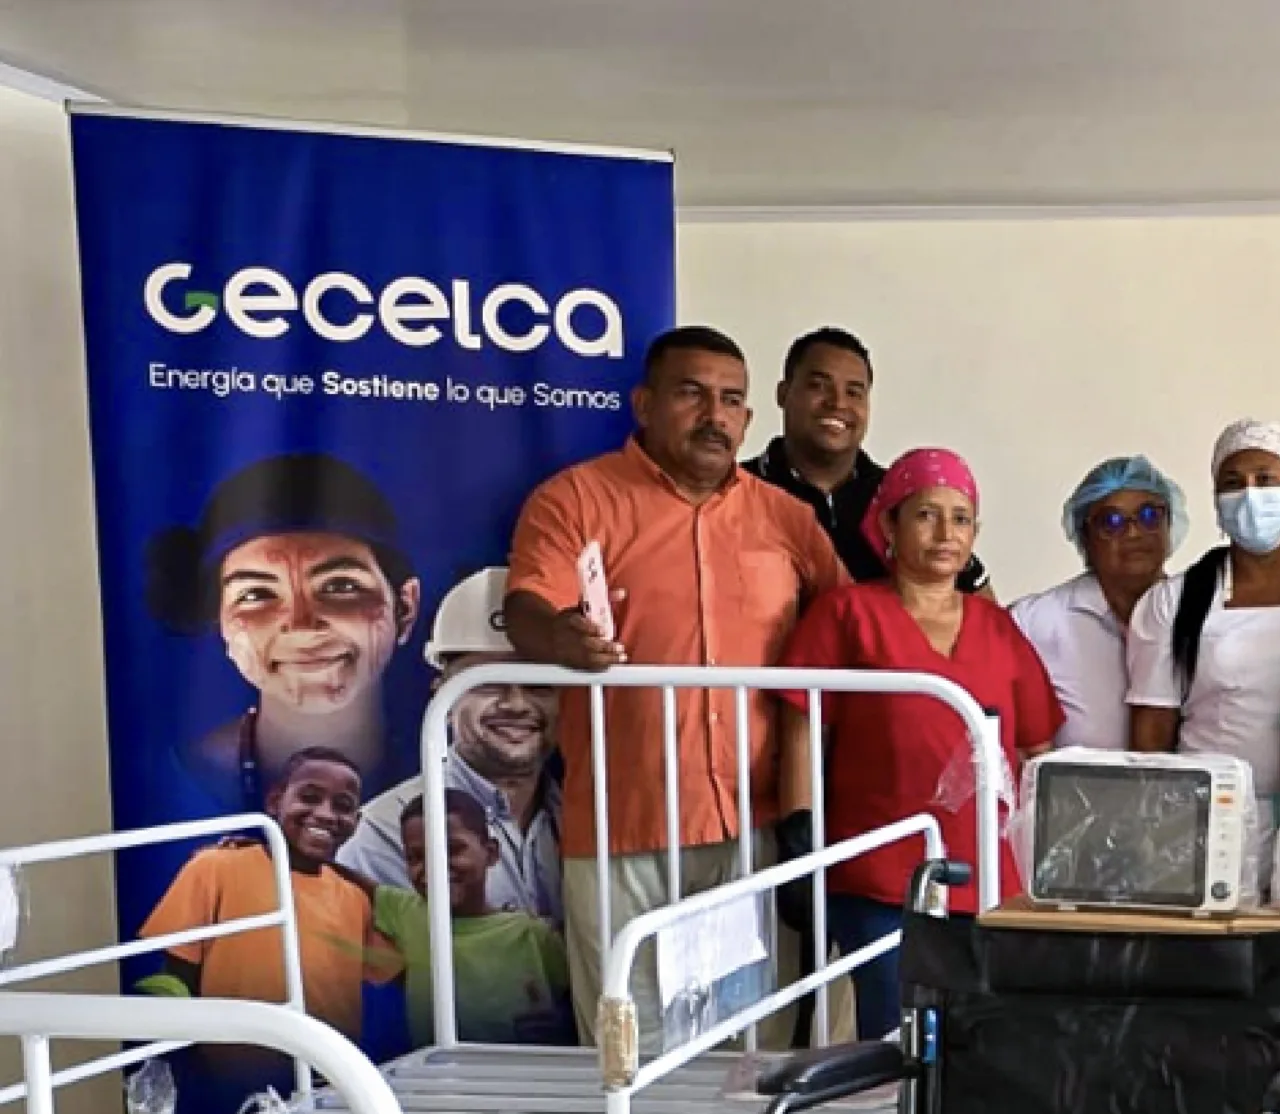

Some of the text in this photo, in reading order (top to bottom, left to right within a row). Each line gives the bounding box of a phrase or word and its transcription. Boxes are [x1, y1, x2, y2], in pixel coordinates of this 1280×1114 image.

[144, 262, 623, 358] Gecelca
[261, 374, 314, 402] que
[321, 371, 440, 401] Sostiene
[446, 377, 470, 403] lo
[475, 385, 527, 412] que
[533, 382, 620, 410] Somos
